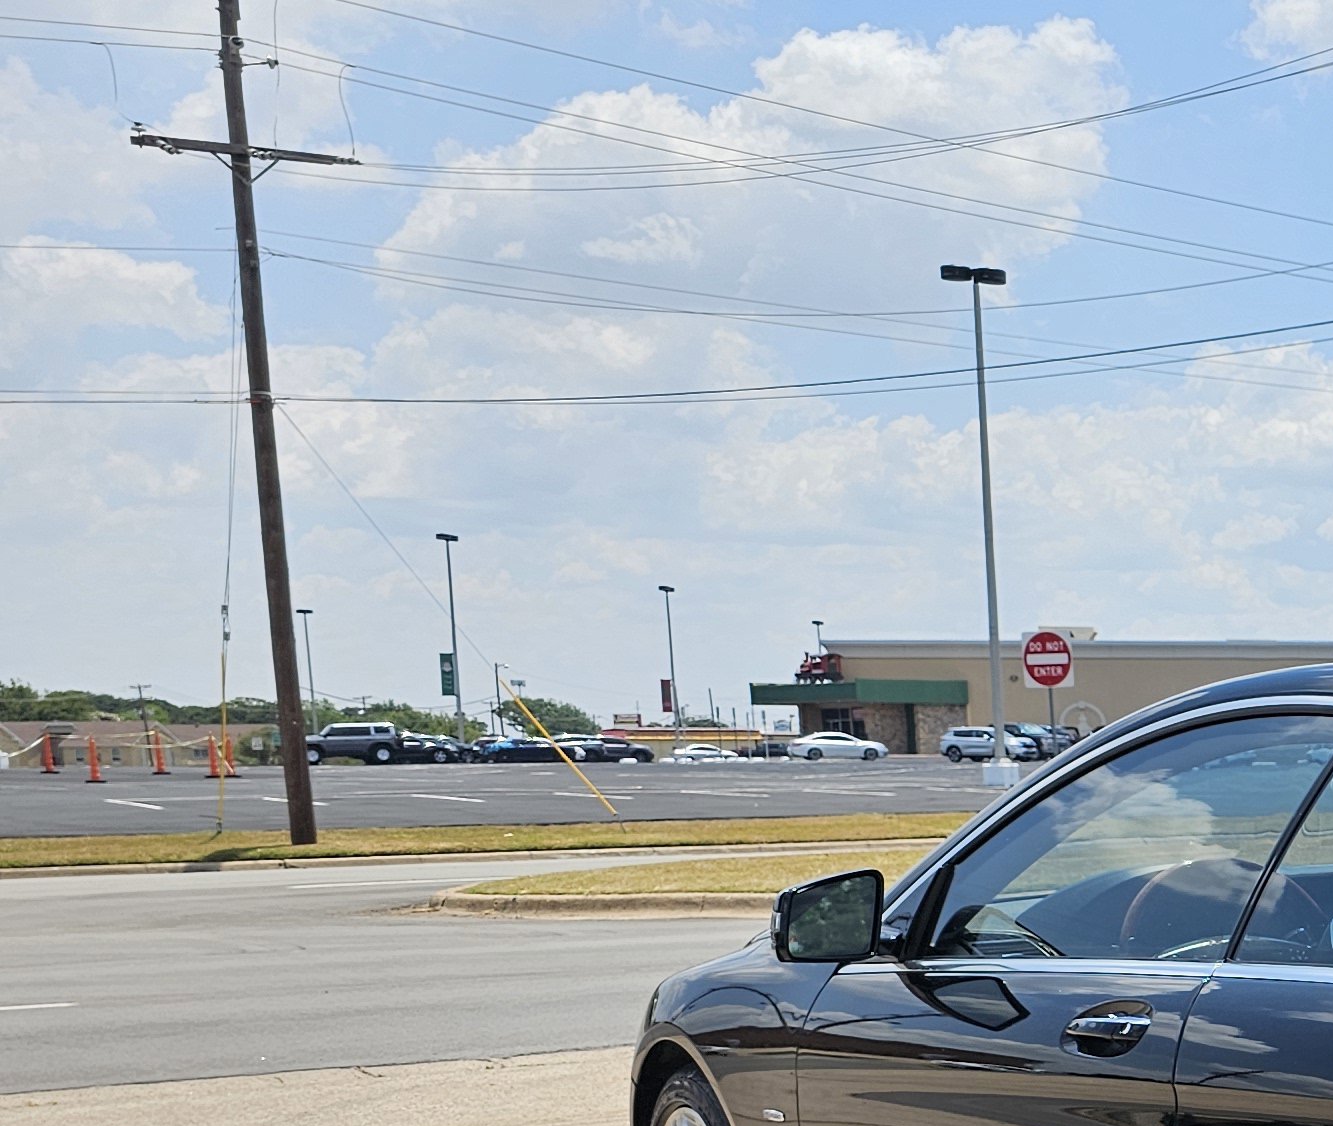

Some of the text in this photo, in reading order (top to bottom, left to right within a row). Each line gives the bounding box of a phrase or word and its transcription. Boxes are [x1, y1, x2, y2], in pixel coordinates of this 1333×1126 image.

[1029, 640, 1064, 652] DO NOT
[1034, 666, 1063, 677] ENTER
